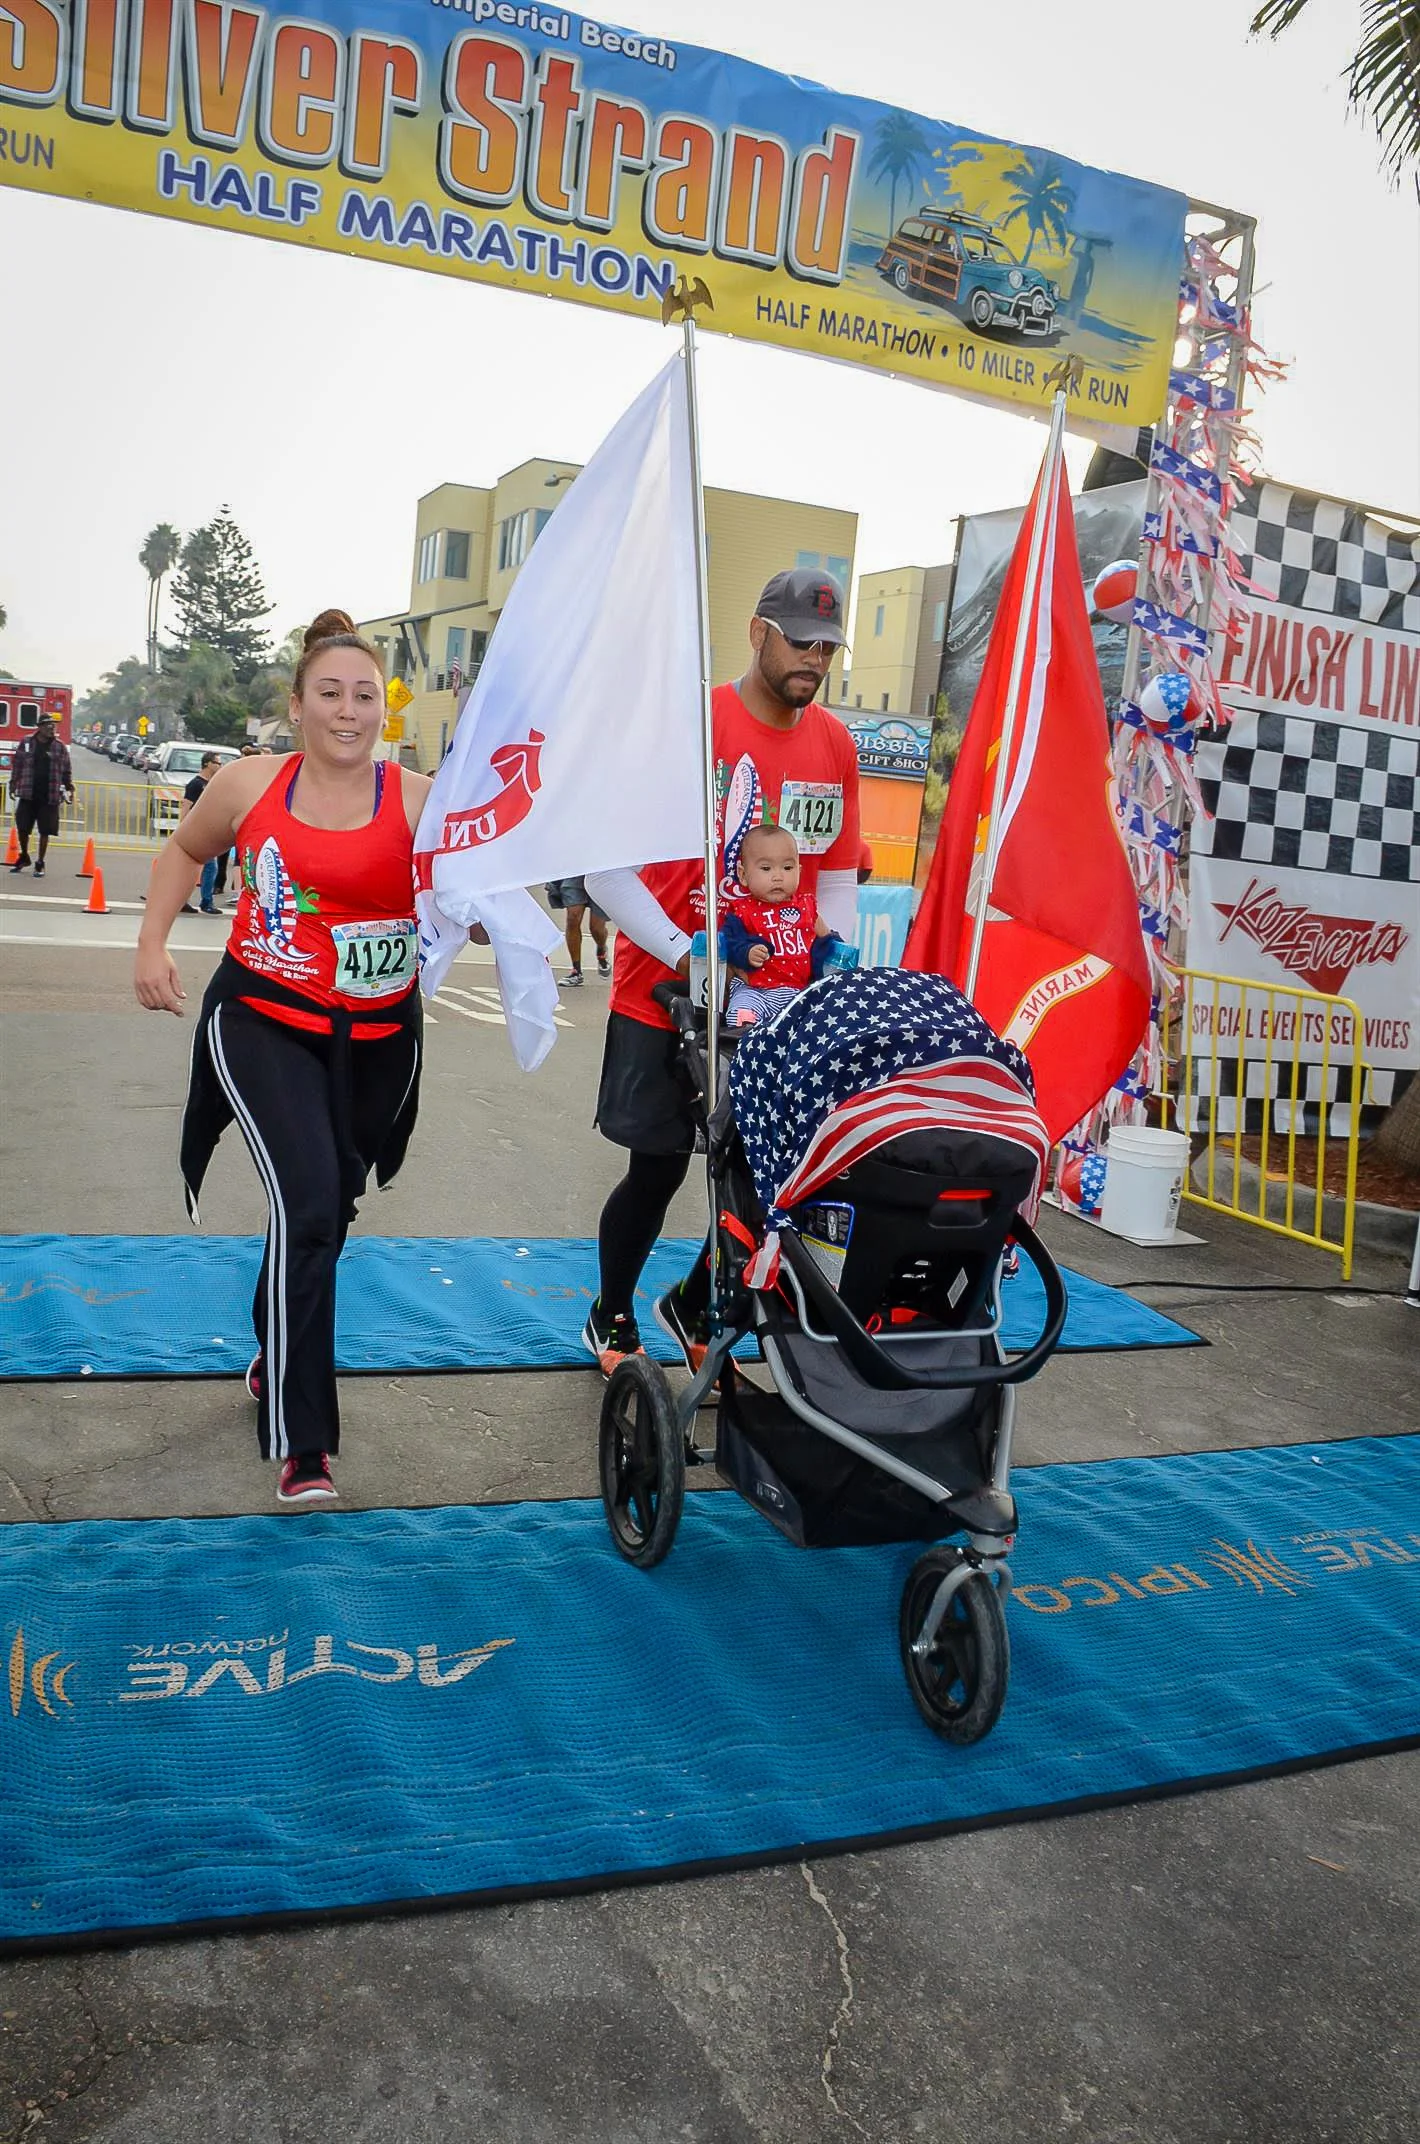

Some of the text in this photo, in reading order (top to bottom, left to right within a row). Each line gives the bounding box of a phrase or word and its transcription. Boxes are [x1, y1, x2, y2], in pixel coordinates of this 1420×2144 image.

[431, 0, 677, 70] perial Beach
[438, 30, 862, 286] Strand
[159, 149, 675, 301] HALF MARATHON
[756, 295, 811, 330] HALF
[818, 308, 936, 360] MARATHON
[958, 343, 976, 371] 10
[982, 350, 1035, 386] MILER
[1088, 377, 1129, 408] RUN
[1220, 606, 1420, 727] FINISH LIN
[857, 752, 890, 766] GIFT
[786, 799, 834, 833] 4121
[762, 909, 778, 929] I
[769, 929, 809, 957] USA
[344, 938, 406, 979] 4122
[1331, 1015, 1411, 1050] SEVICES
[119, 1635, 512, 1701] ACTIVE
